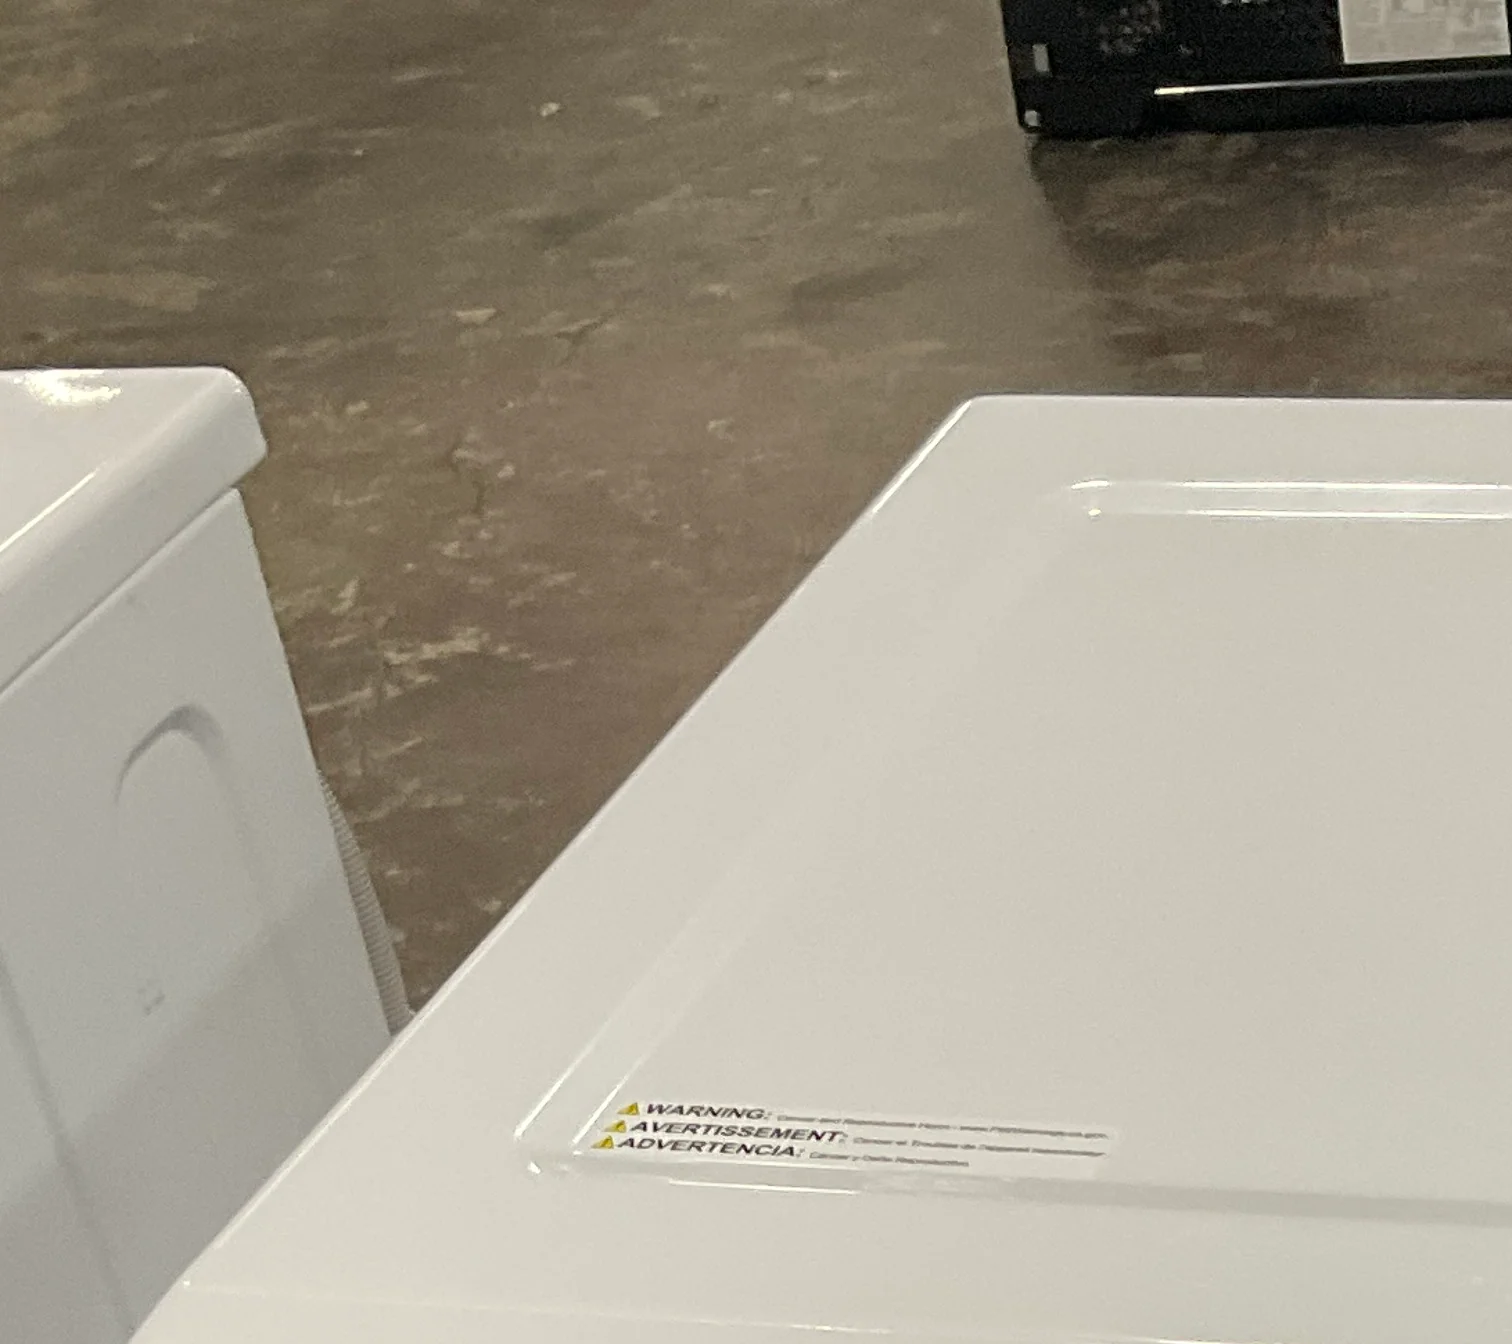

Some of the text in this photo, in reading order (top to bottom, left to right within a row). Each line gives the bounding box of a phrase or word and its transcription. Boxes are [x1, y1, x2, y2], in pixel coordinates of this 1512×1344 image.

[646, 1103, 772, 1120] WARNING:
[629, 1121, 848, 1143] AVERTISSEMENT:
[617, 1137, 805, 1158] ADVERTENCIA:
